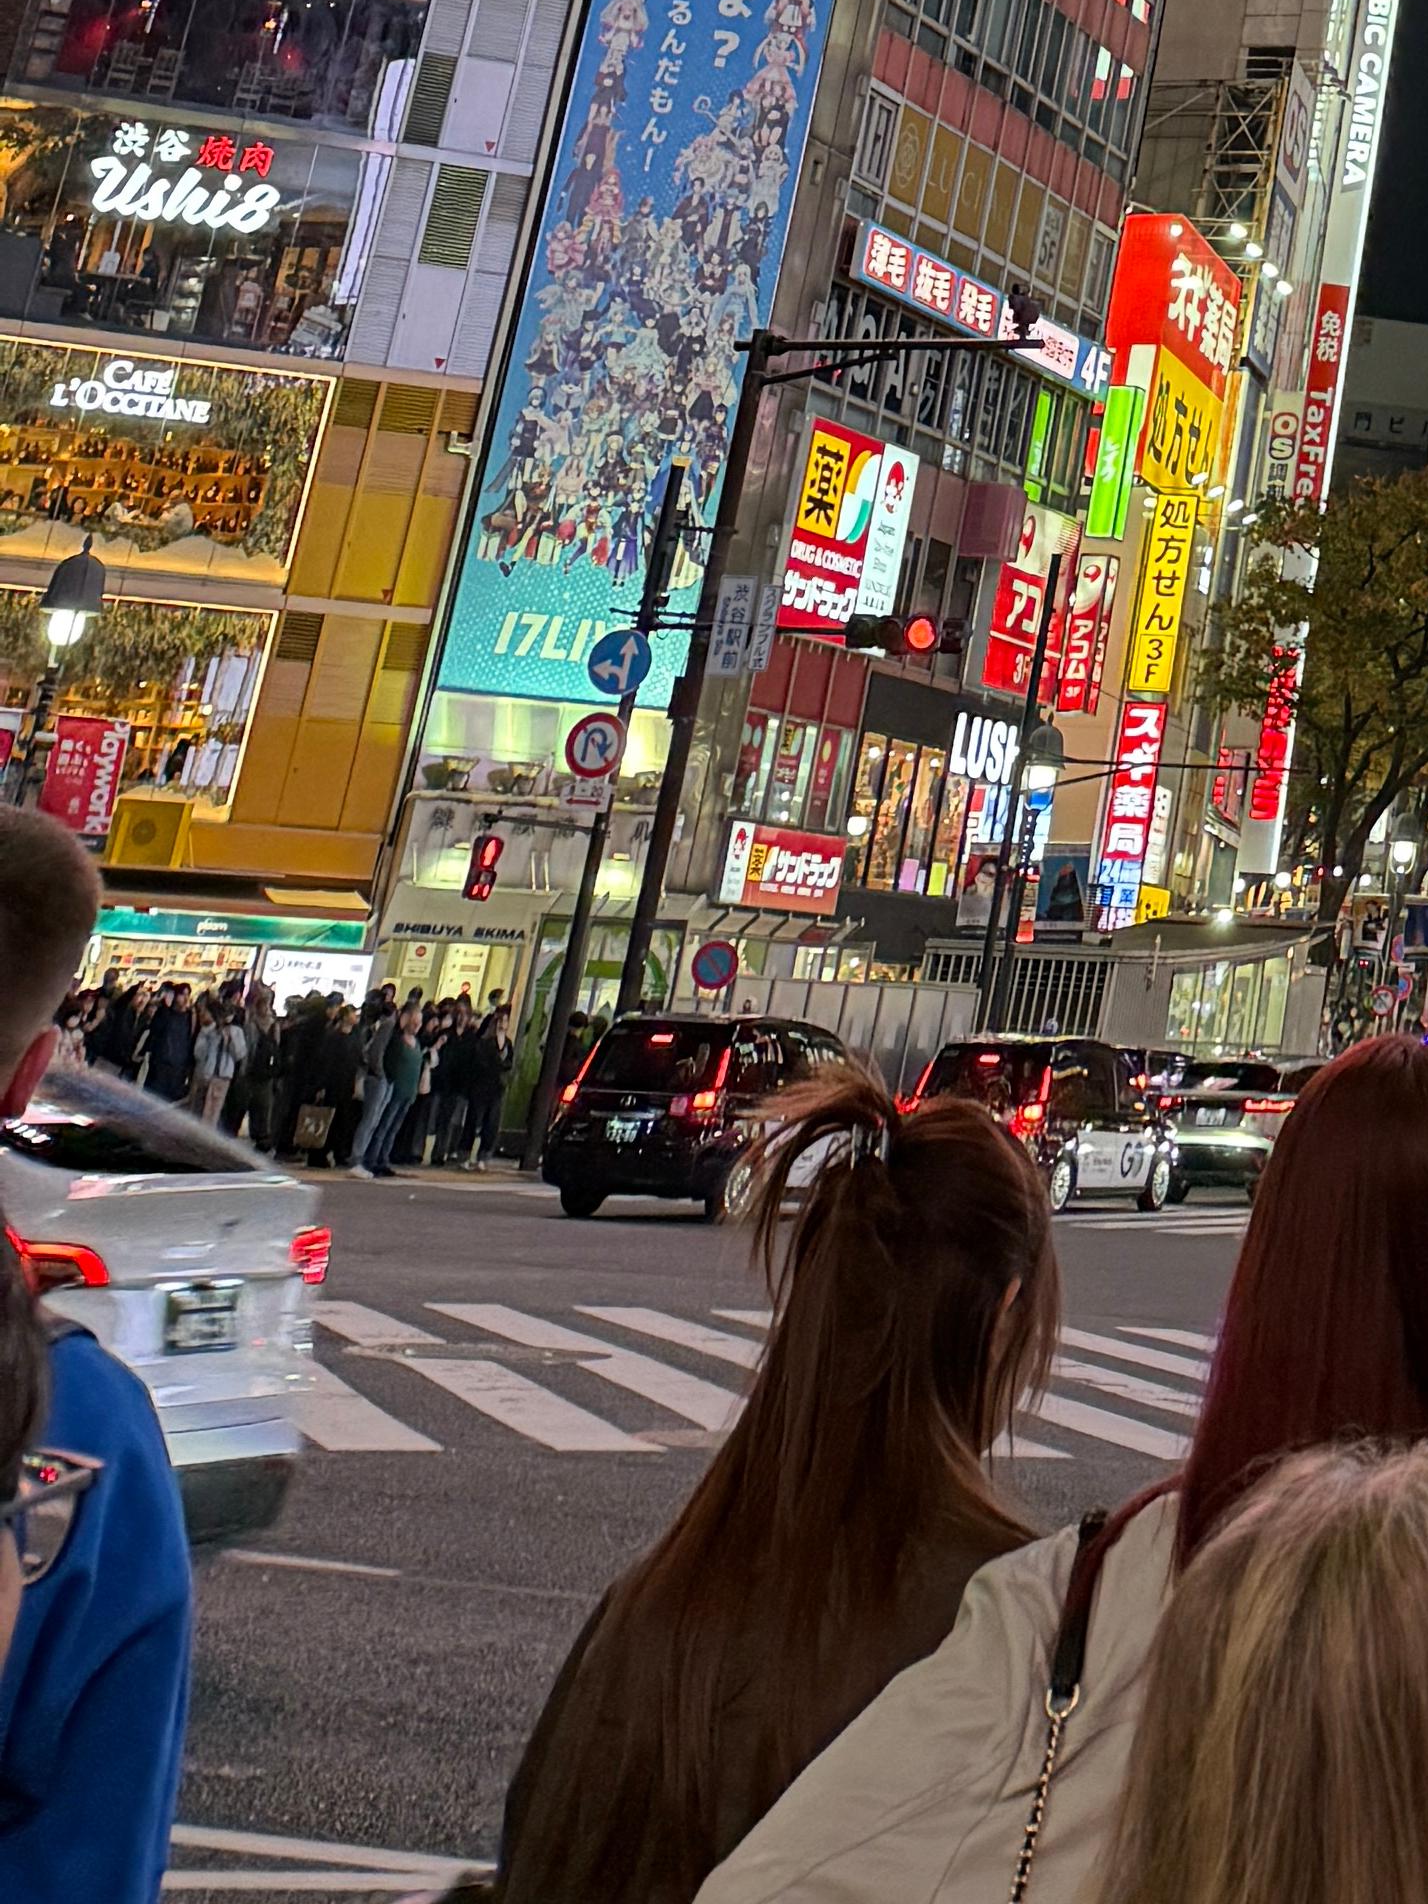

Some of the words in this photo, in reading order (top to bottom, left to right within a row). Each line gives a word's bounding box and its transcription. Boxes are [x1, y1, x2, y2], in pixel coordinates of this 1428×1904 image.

[1341, 53, 1384, 186] CAMERA
[89, 155, 281, 234] Ushi8
[1315, 310, 1343, 364] 免税
[50, 379, 211, 425] L'OCCITANE
[1144, 499, 1191, 632] 処方せん
[493, 610, 634, 664] 17LIV
[721, 583, 750, 669] 渋谷駅前
[1066, 619, 1095, 681] アコム
[1105, 707, 1162, 856] スギ薬局
[393, 922, 463, 938] SHIBUYA
